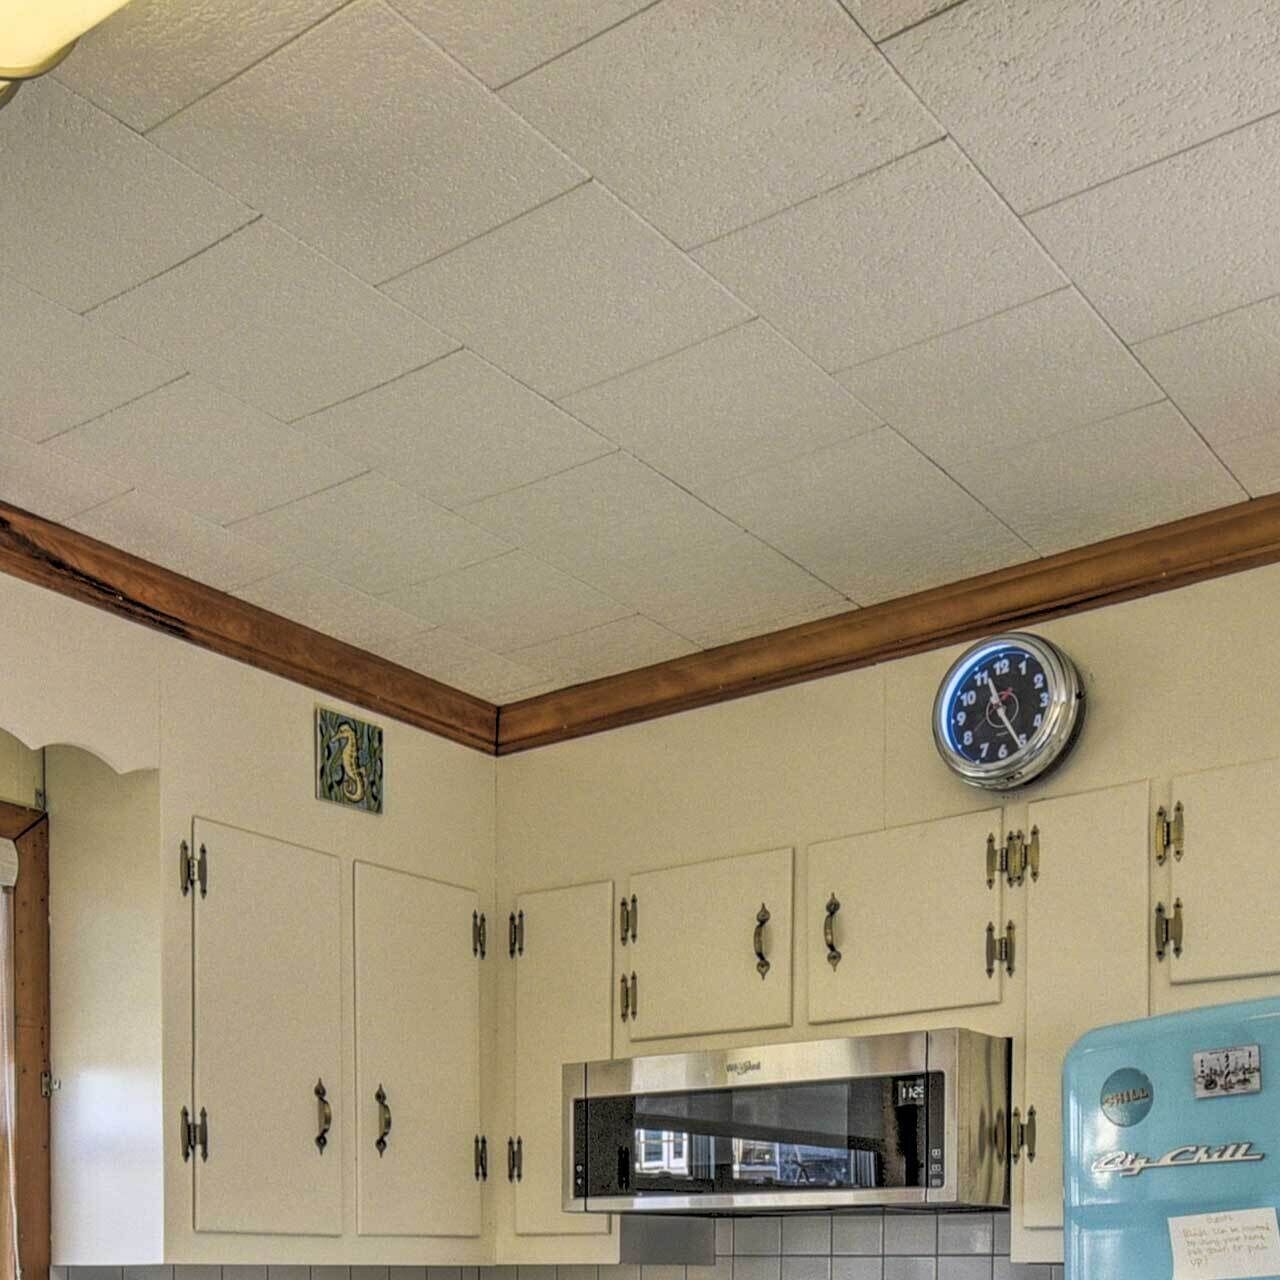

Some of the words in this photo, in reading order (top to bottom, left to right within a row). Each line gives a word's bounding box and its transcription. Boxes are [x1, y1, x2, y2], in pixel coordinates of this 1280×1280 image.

[993, 659, 1010, 675] 12
[1018, 661, 1027, 675] 1
[974, 670, 989, 686] 11
[1033, 674, 1044, 689] 2
[960, 691, 976, 706] 10
[1040, 693, 1049, 707] 3
[956, 712, 966, 726] 9
[1033, 714, 1042, 727] 4
[963, 731, 973, 745] 8
[1018, 734, 1027, 749] 5
[979, 742, 990, 758] 7
[997, 744, 1008, 758] 6
[1158, 1142, 1265, 1165] Chill
